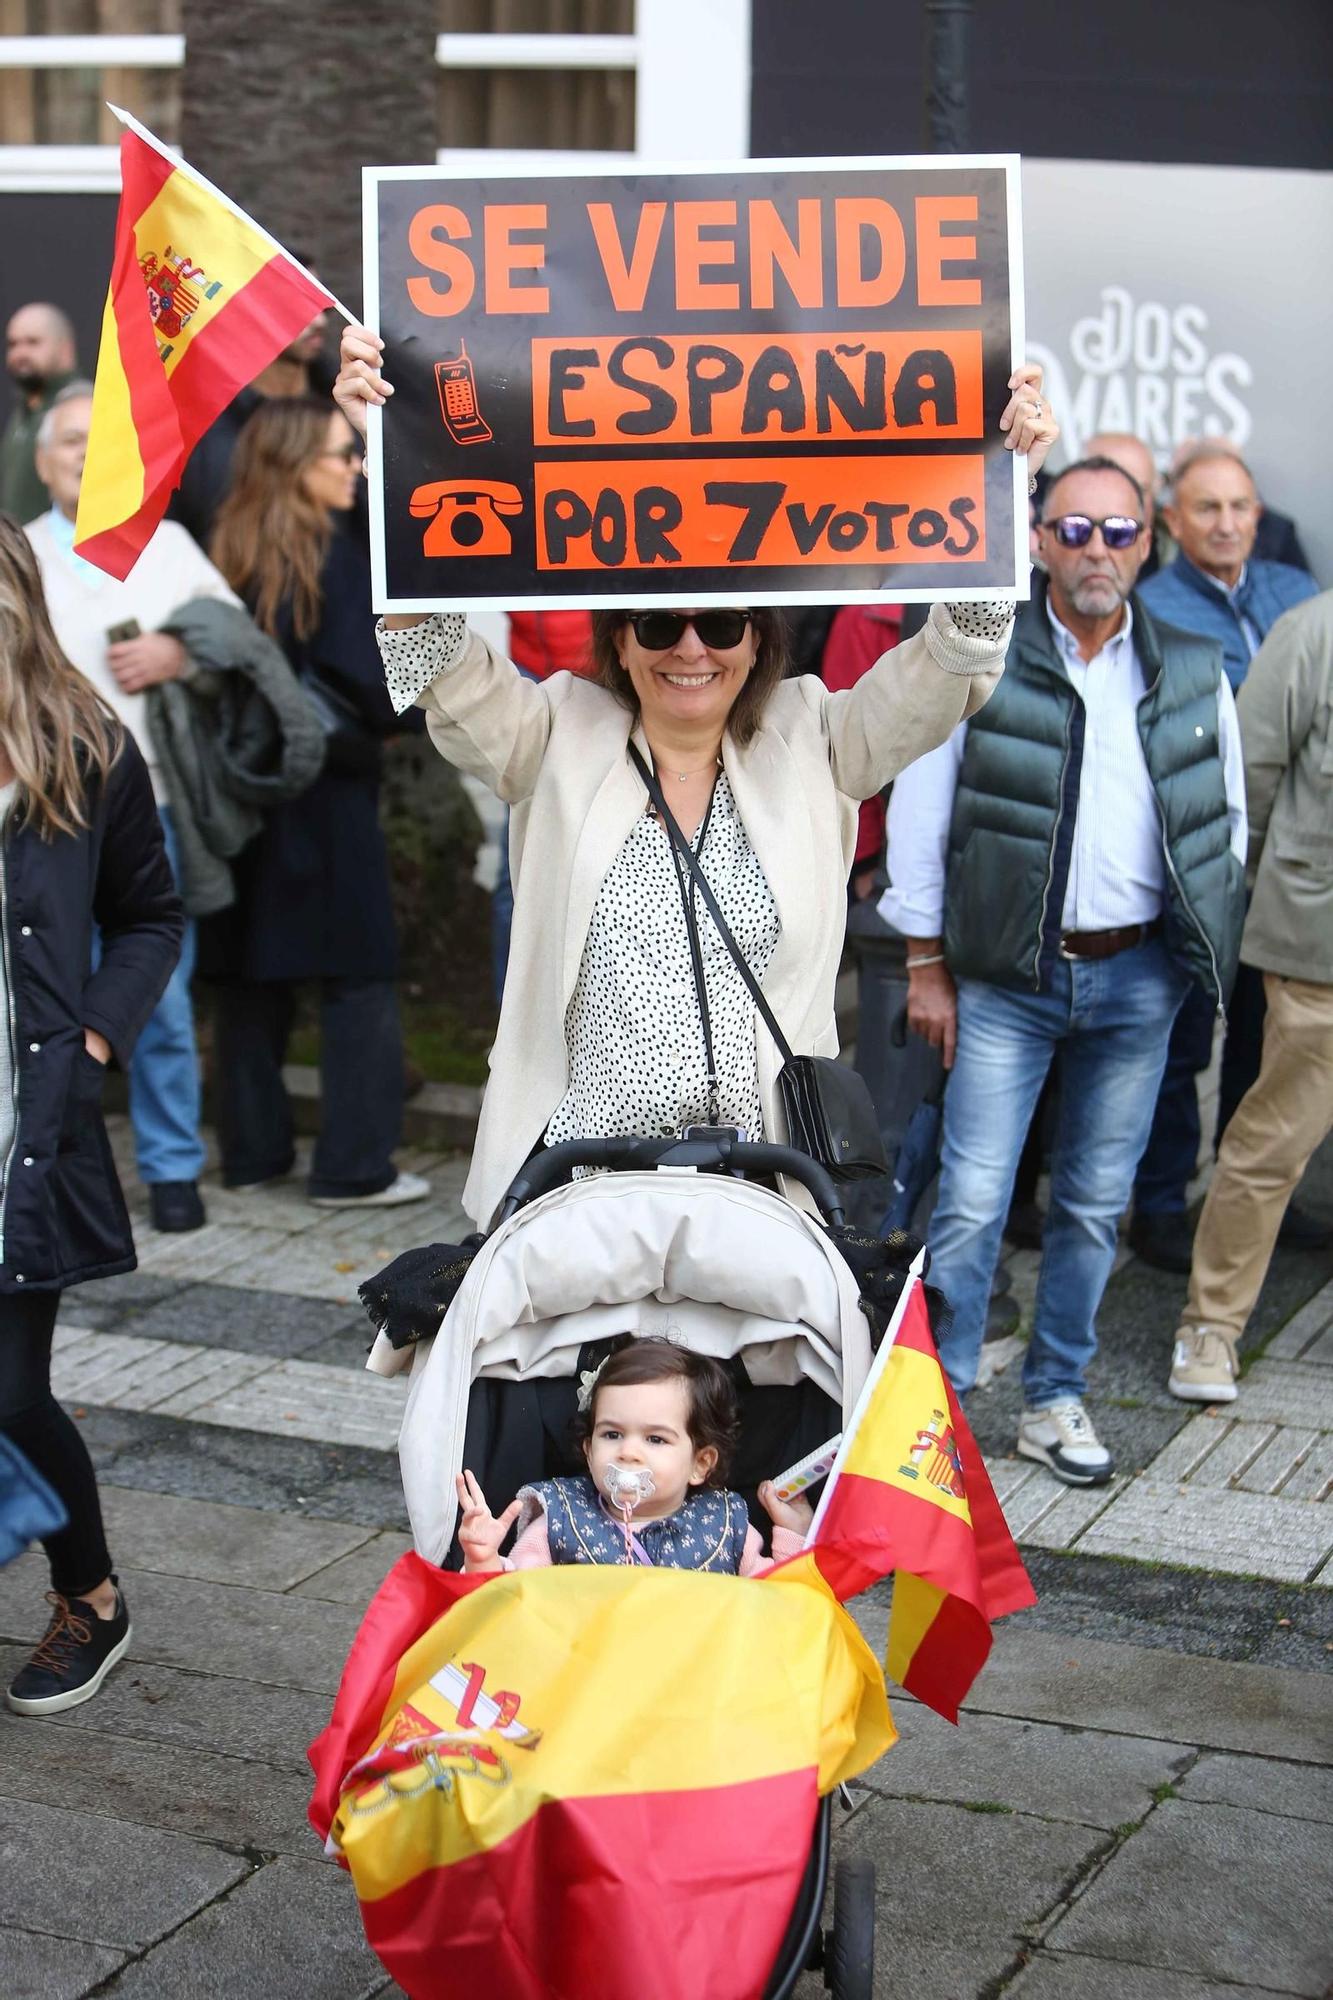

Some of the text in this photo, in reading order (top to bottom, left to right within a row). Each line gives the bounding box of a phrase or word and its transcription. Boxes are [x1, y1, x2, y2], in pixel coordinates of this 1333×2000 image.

[406, 195, 982, 317] SE VENDE
[1070, 284, 1209, 374] DOS
[547, 336, 957, 437] ESPAÑA
[1025, 341, 1253, 463] MARES
[543, 485, 683, 567] POR
[703, 480, 787, 563] 7
